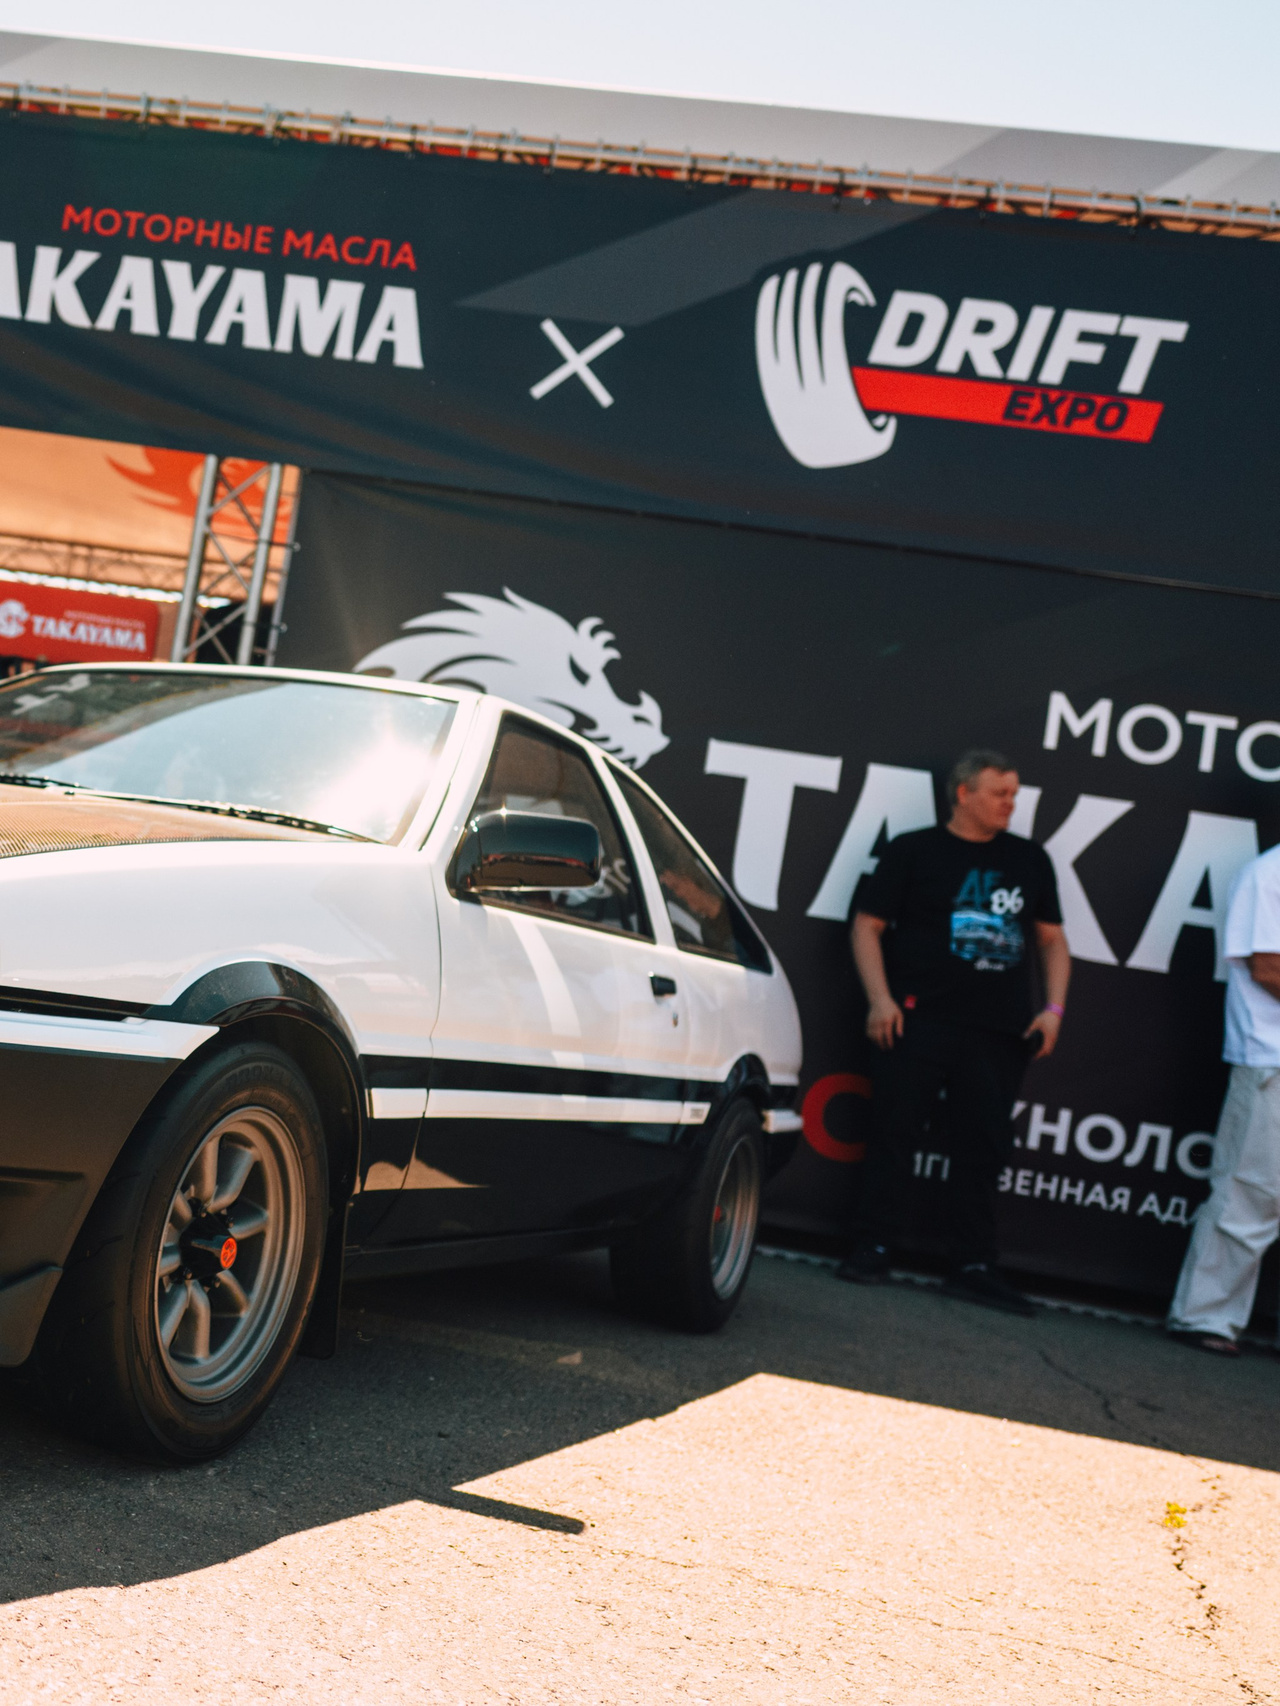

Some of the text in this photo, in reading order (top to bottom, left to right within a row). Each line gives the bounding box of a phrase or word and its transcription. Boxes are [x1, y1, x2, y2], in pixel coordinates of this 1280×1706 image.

[61, 204, 418, 271] МОТОРНЫЕ МАСЛА
[867, 290, 1189, 394] DRIFT
[1002, 389, 1130, 433] EXPO
[32, 615, 146, 651] TAKAYAMA
[990, 886, 1024, 915] 86
[1010, 1101, 1218, 1178] НОЛО
[997, 1166, 1131, 1213] ВЕННАЯ
[1138, 1195, 1198, 1226] АД
